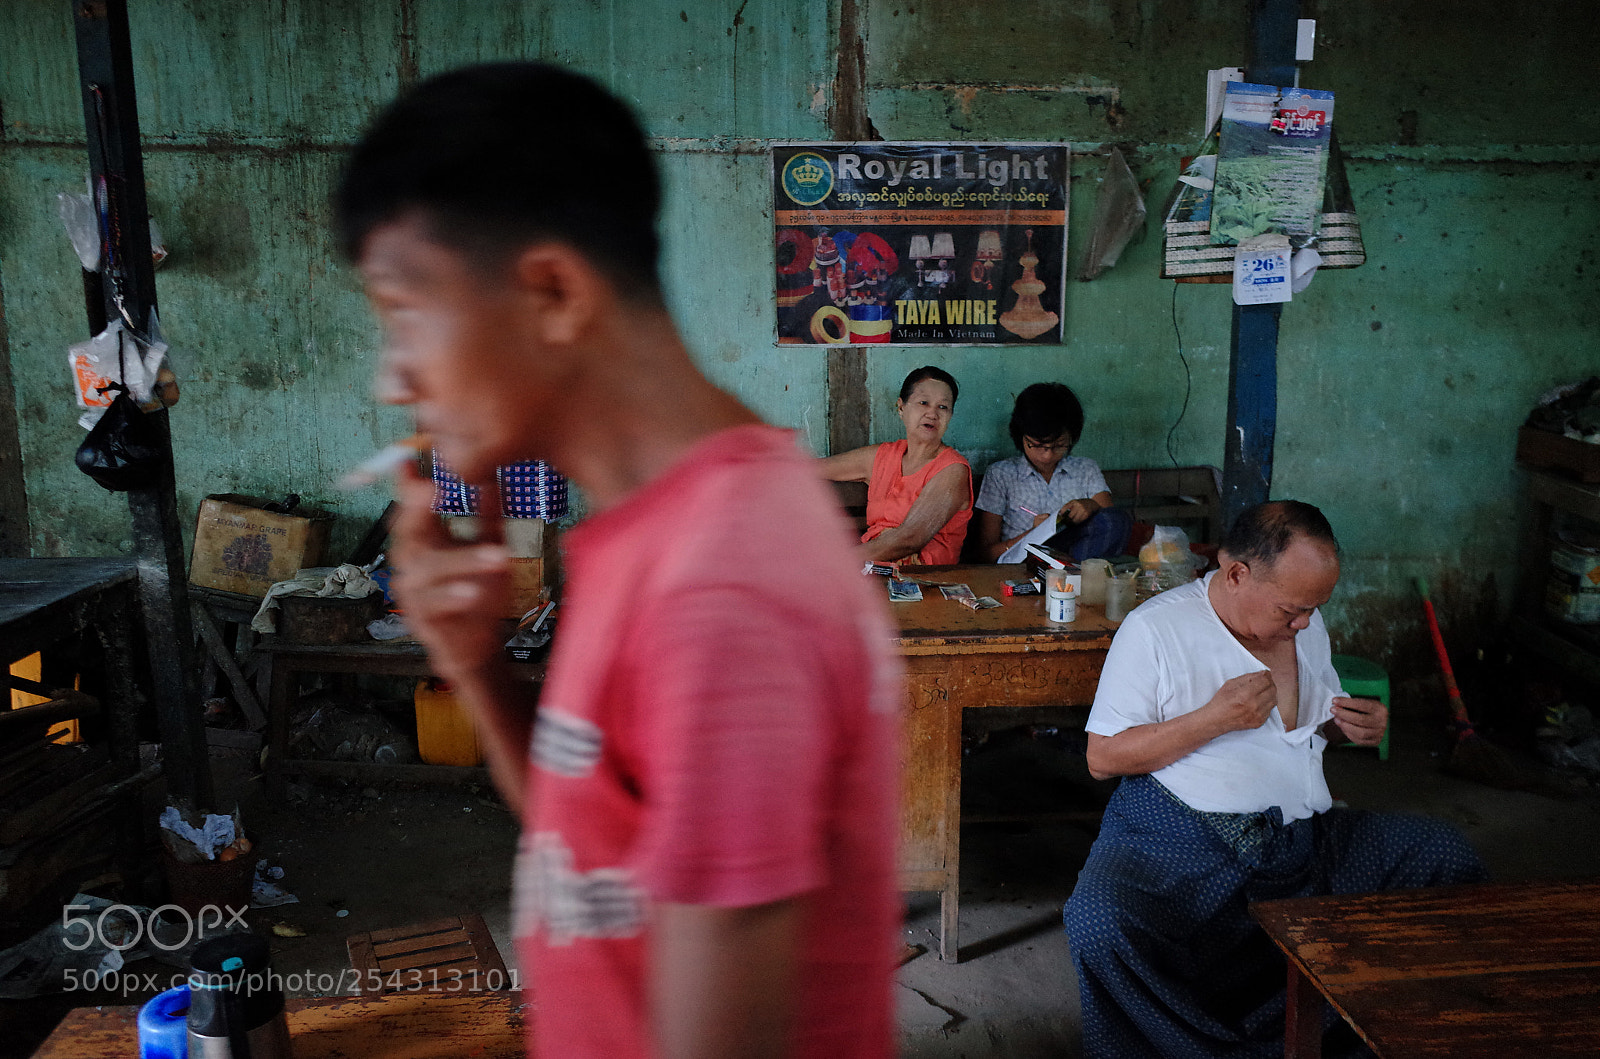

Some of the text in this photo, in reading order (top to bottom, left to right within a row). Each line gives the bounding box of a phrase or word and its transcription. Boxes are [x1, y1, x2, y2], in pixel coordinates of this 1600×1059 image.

[837, 153, 1049, 186] Royal Light
[1252, 258, 1274, 271] 26
[895, 300, 998, 325] TAYA WIRE
[897, 329, 996, 338] Made In Vietnam
[217, 517, 287, 537] MYANMAR GRAPE
